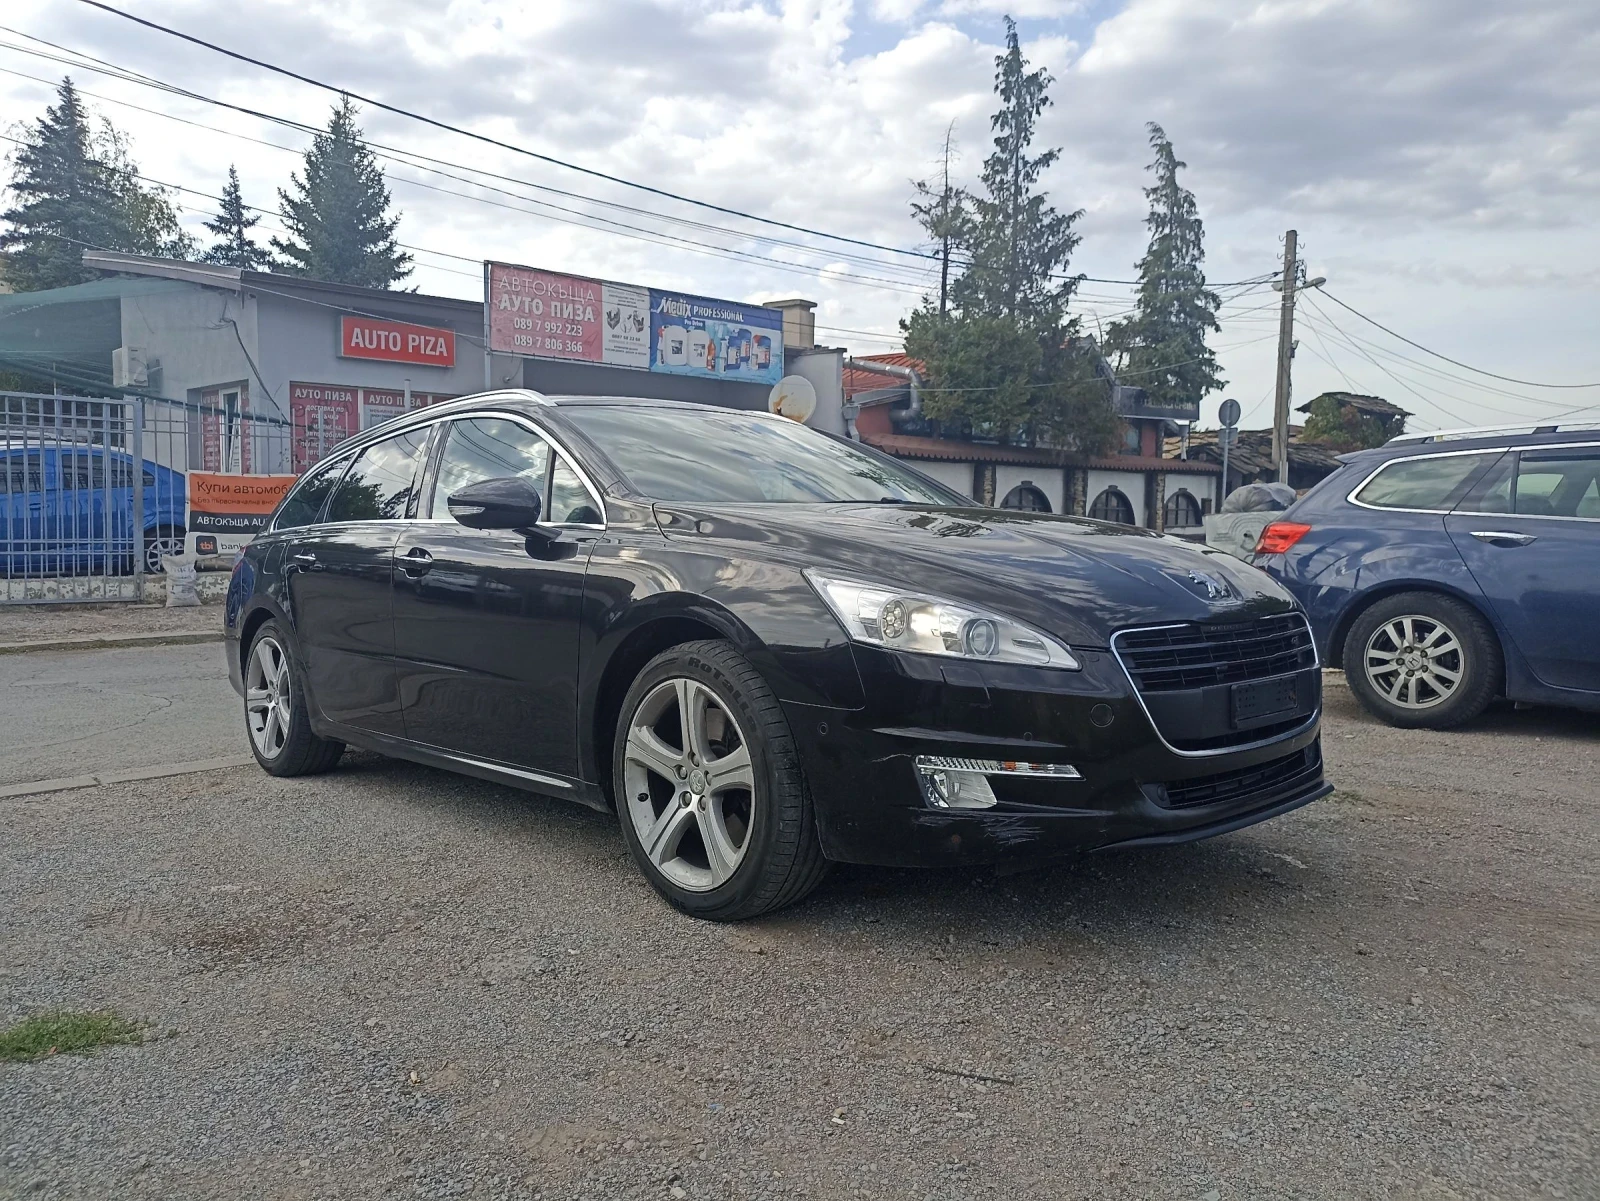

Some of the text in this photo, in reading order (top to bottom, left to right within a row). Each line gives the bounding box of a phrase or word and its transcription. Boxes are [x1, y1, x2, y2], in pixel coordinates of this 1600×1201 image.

[499, 275, 595, 304] АВТОКЪЩА
[500, 293, 595, 322] АУТО ПИЗА
[656, 296, 692, 318] Medix
[693, 306, 744, 322] PROFESSIONAL
[514, 317, 583, 336] 089 7 992 223
[350, 328, 448, 356] AUTO PIZA
[514, 334, 583, 352] 089 7 806 366
[294, 388, 352, 402] АУТО ПИЗА
[369, 394, 422, 406] АУТО ПЗА
[197, 481, 289, 495] Купи автомоб
[196, 516, 268, 528] АВТОКЪЩА AU
[200, 542, 214, 550] tbi
